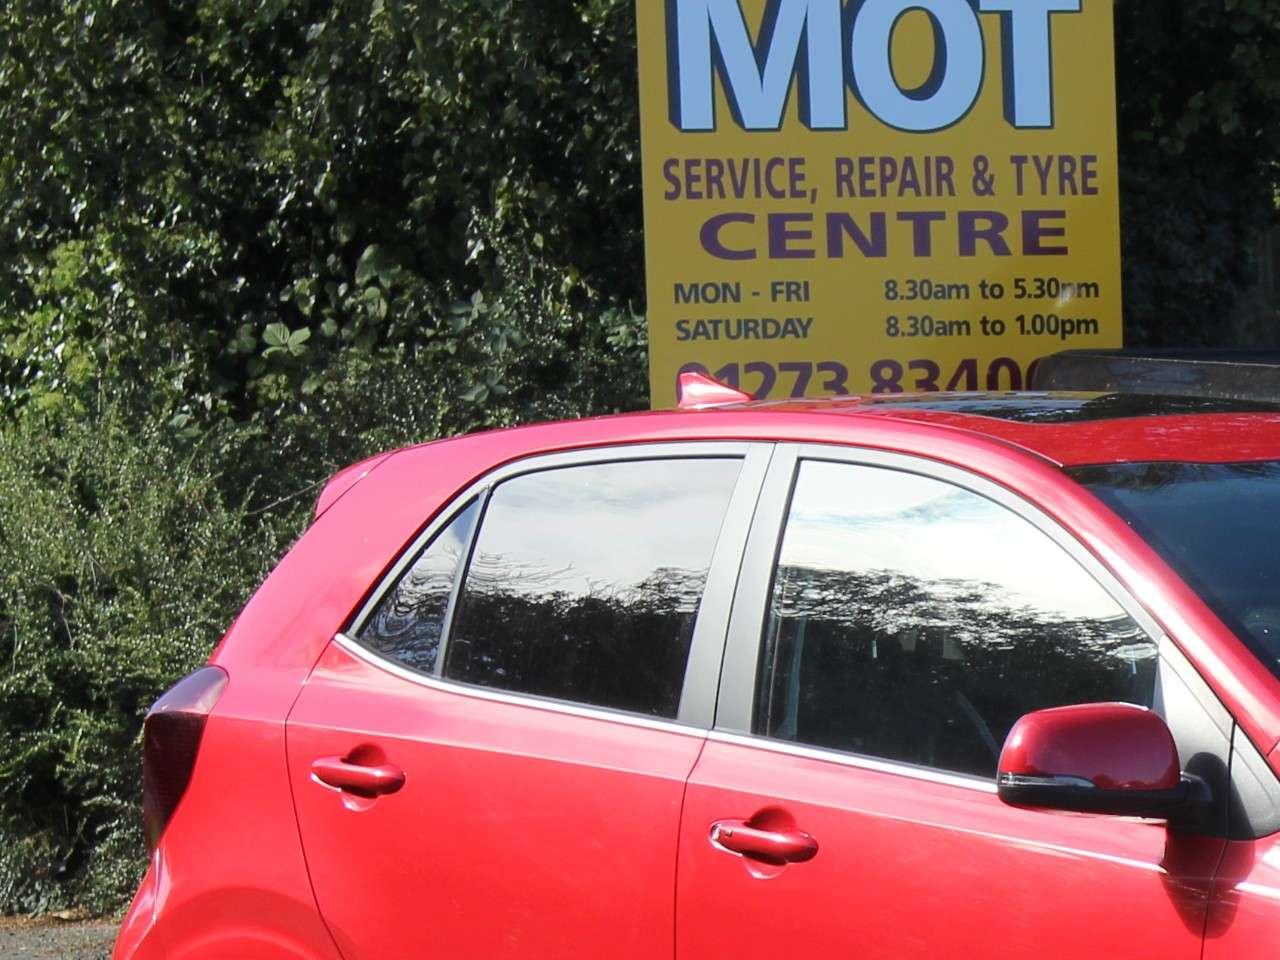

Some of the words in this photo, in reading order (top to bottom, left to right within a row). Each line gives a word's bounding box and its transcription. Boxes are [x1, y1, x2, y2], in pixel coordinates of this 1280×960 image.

[667, 0, 1082, 134] MOT
[663, 157, 818, 204] SERVICE,
[835, 155, 956, 198] REPAIR
[972, 154, 995, 197] &
[1010, 154, 1099, 197] TYRE
[699, 209, 1069, 261] CENTRE
[674, 281, 742, 304] MON
[770, 280, 810, 302] FRI
[884, 278, 970, 301] 8.30am
[978, 279, 1005, 300] to
[675, 317, 814, 342] SATURDAY
[886, 315, 971, 337] 8.30am
[979, 315, 1006, 336] to
[1015, 313, 1099, 340] 1.00pm
